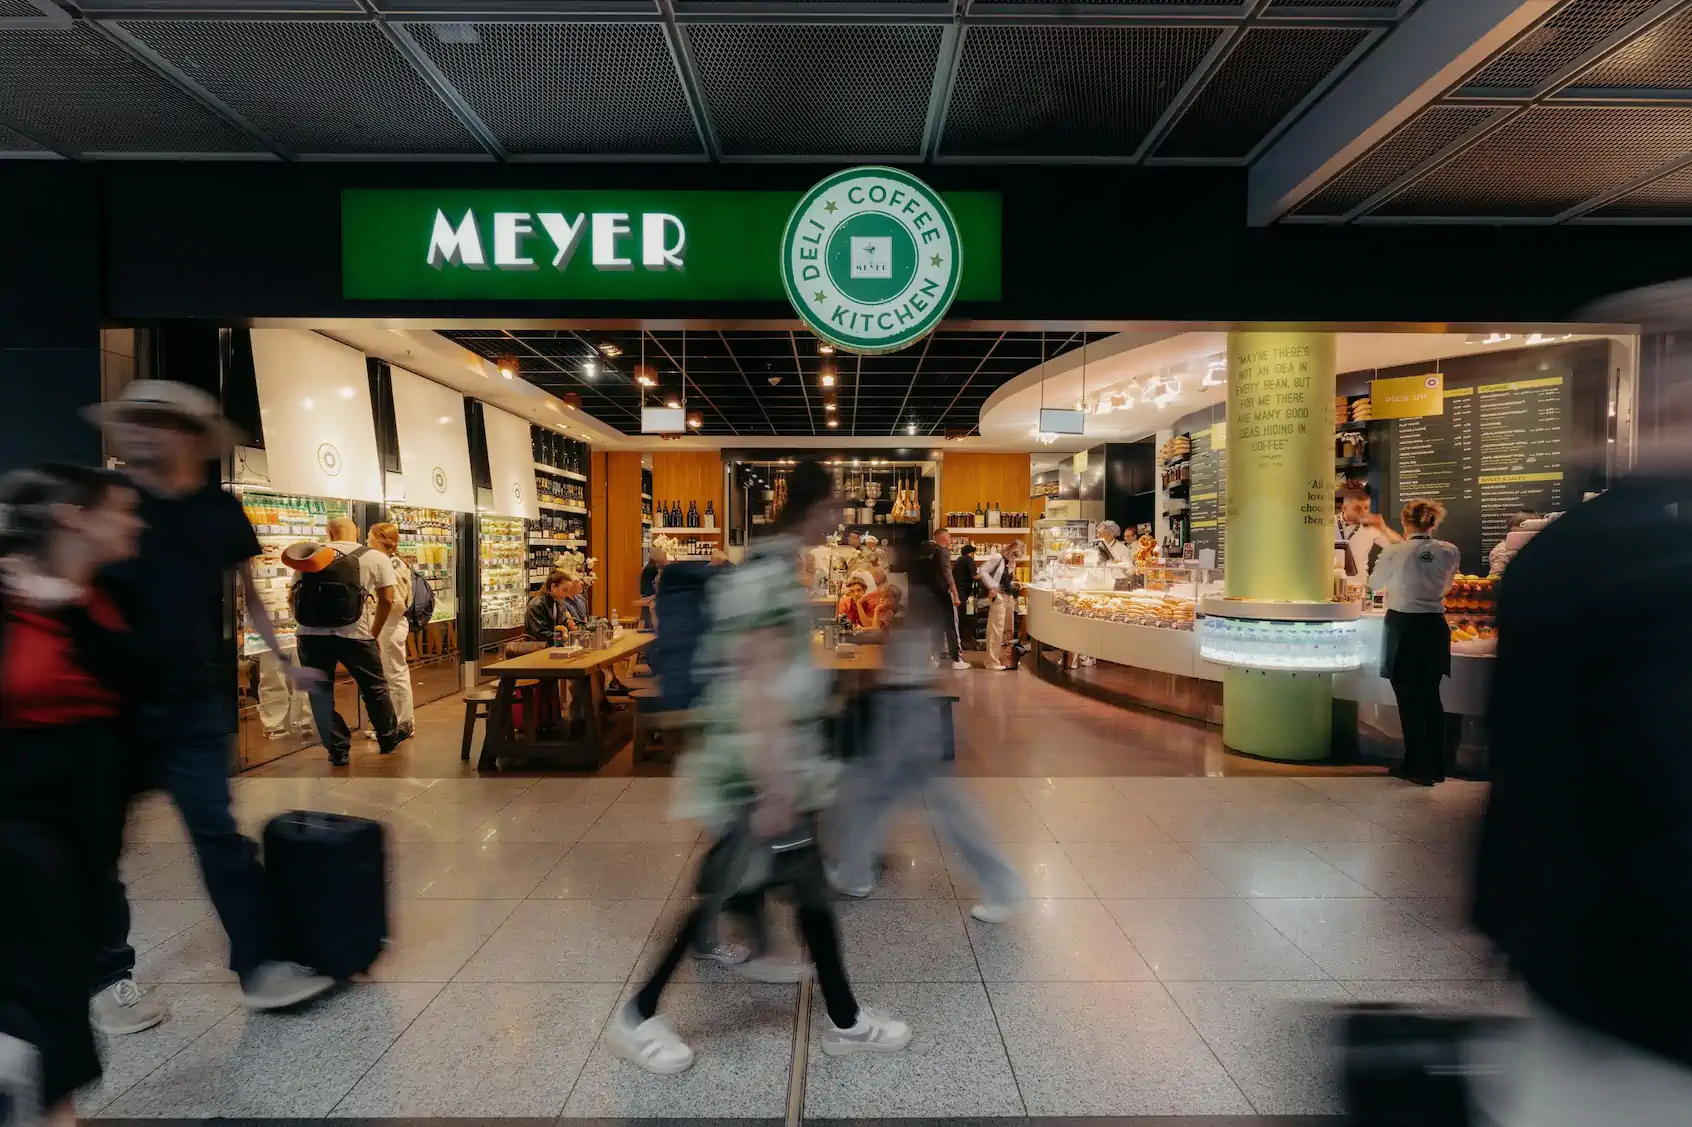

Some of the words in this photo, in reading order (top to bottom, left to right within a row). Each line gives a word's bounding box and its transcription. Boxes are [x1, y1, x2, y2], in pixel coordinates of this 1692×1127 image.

[848, 185, 940, 245] COFFEE
[426, 207, 688, 271] MEYER
[800, 219, 826, 281] DELI
[831, 278, 940, 332] KITCHEN
[1273, 346, 1309, 358] THERE'S
[1238, 368, 1253, 380] NOT
[1257, 365, 1269, 377] AN
[1275, 362, 1294, 374] IDEA
[1299, 361, 1307, 373] IN
[1236, 381, 1259, 396] EVERY
[1294, 376, 1312, 388] BUT
[1240, 397, 1254, 409] FOR
[1258, 394, 1271, 406] ME
[1275, 392, 1304, 405] THERE
[1237, 411, 1251, 424] ARE
[1254, 408, 1282, 421] MANY
[1286, 407, 1309, 419] GOOD
[1239, 426, 1260, 439] IDEAS
[1264, 423, 1294, 436] HIDING
[1298, 422, 1307, 434] IN
